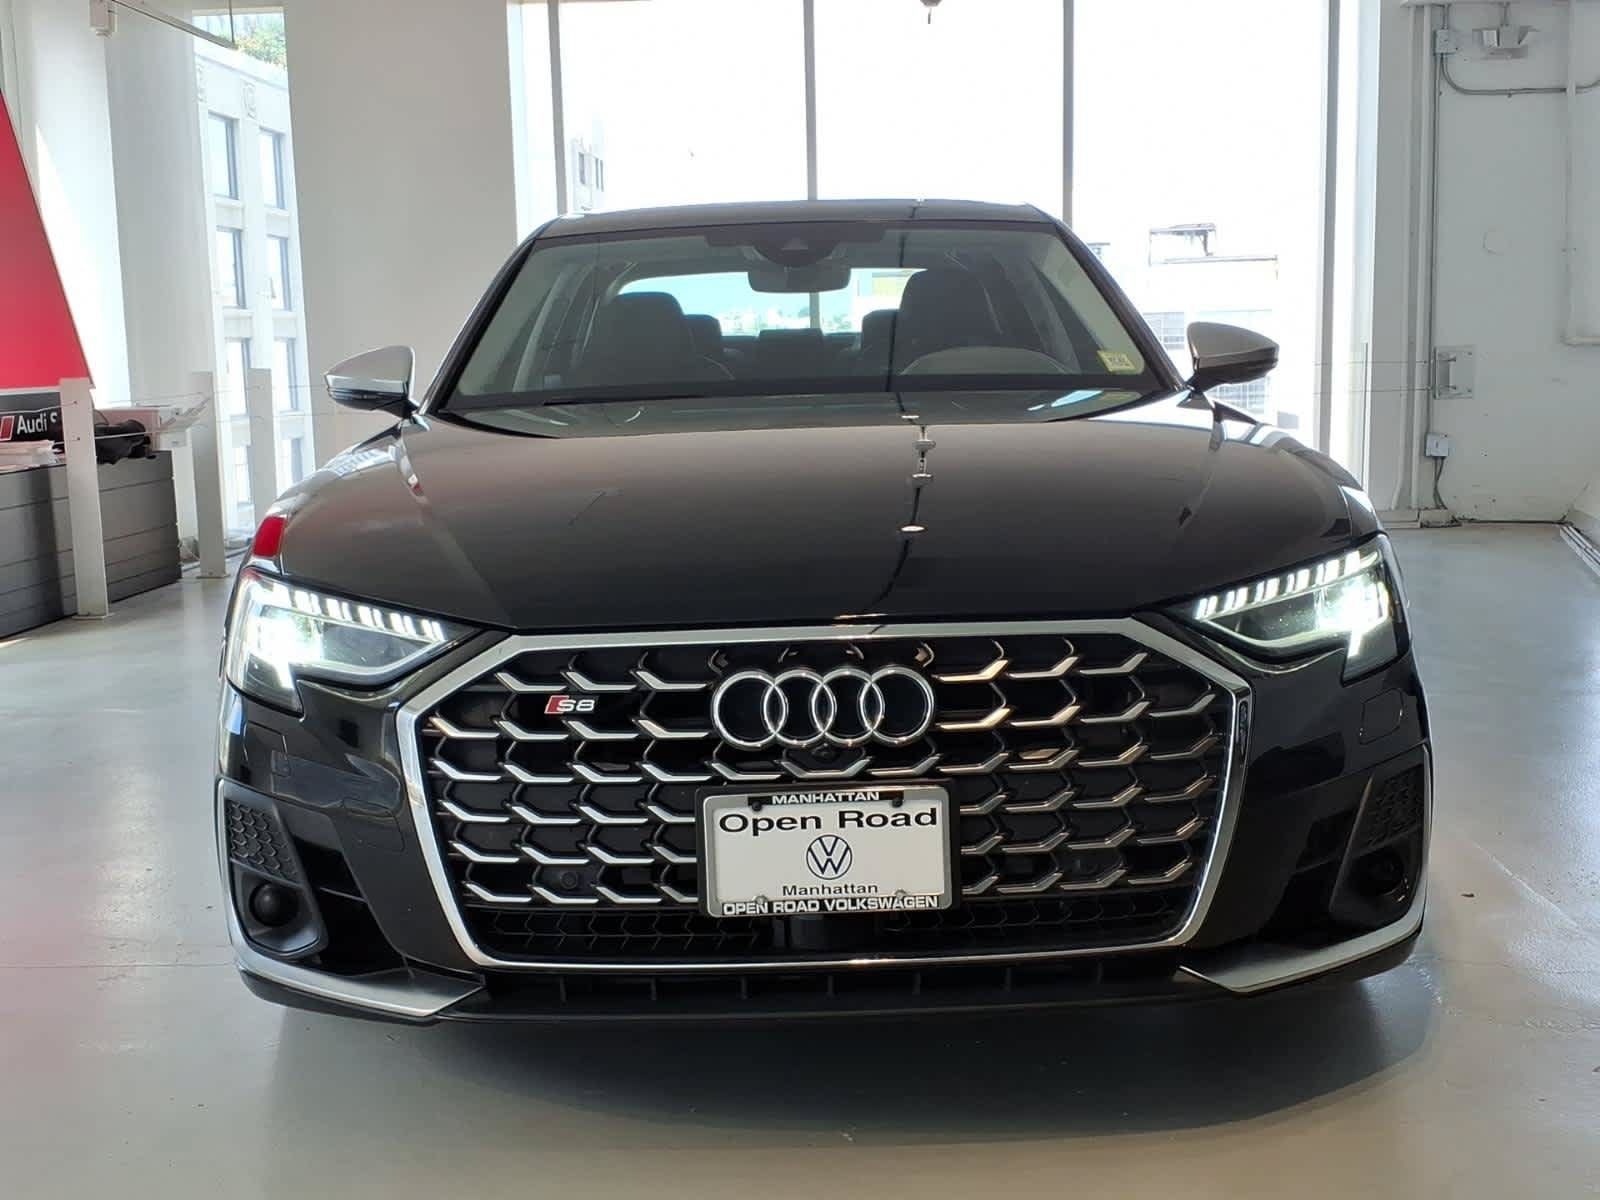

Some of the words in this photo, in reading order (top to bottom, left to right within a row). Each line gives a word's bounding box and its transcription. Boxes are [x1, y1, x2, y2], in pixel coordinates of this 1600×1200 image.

[16, 412, 48, 435] Audi
[556, 699, 596, 712] S8
[771, 791, 880, 805] MANHATTAN
[719, 813, 822, 837] Open
[838, 807, 937, 829] Road
[782, 883, 878, 896] Manhattan
[723, 901, 769, 915] OPEN
[772, 900, 820, 913] ROAD
[823, 895, 938, 911] VOLKSWAGEN
